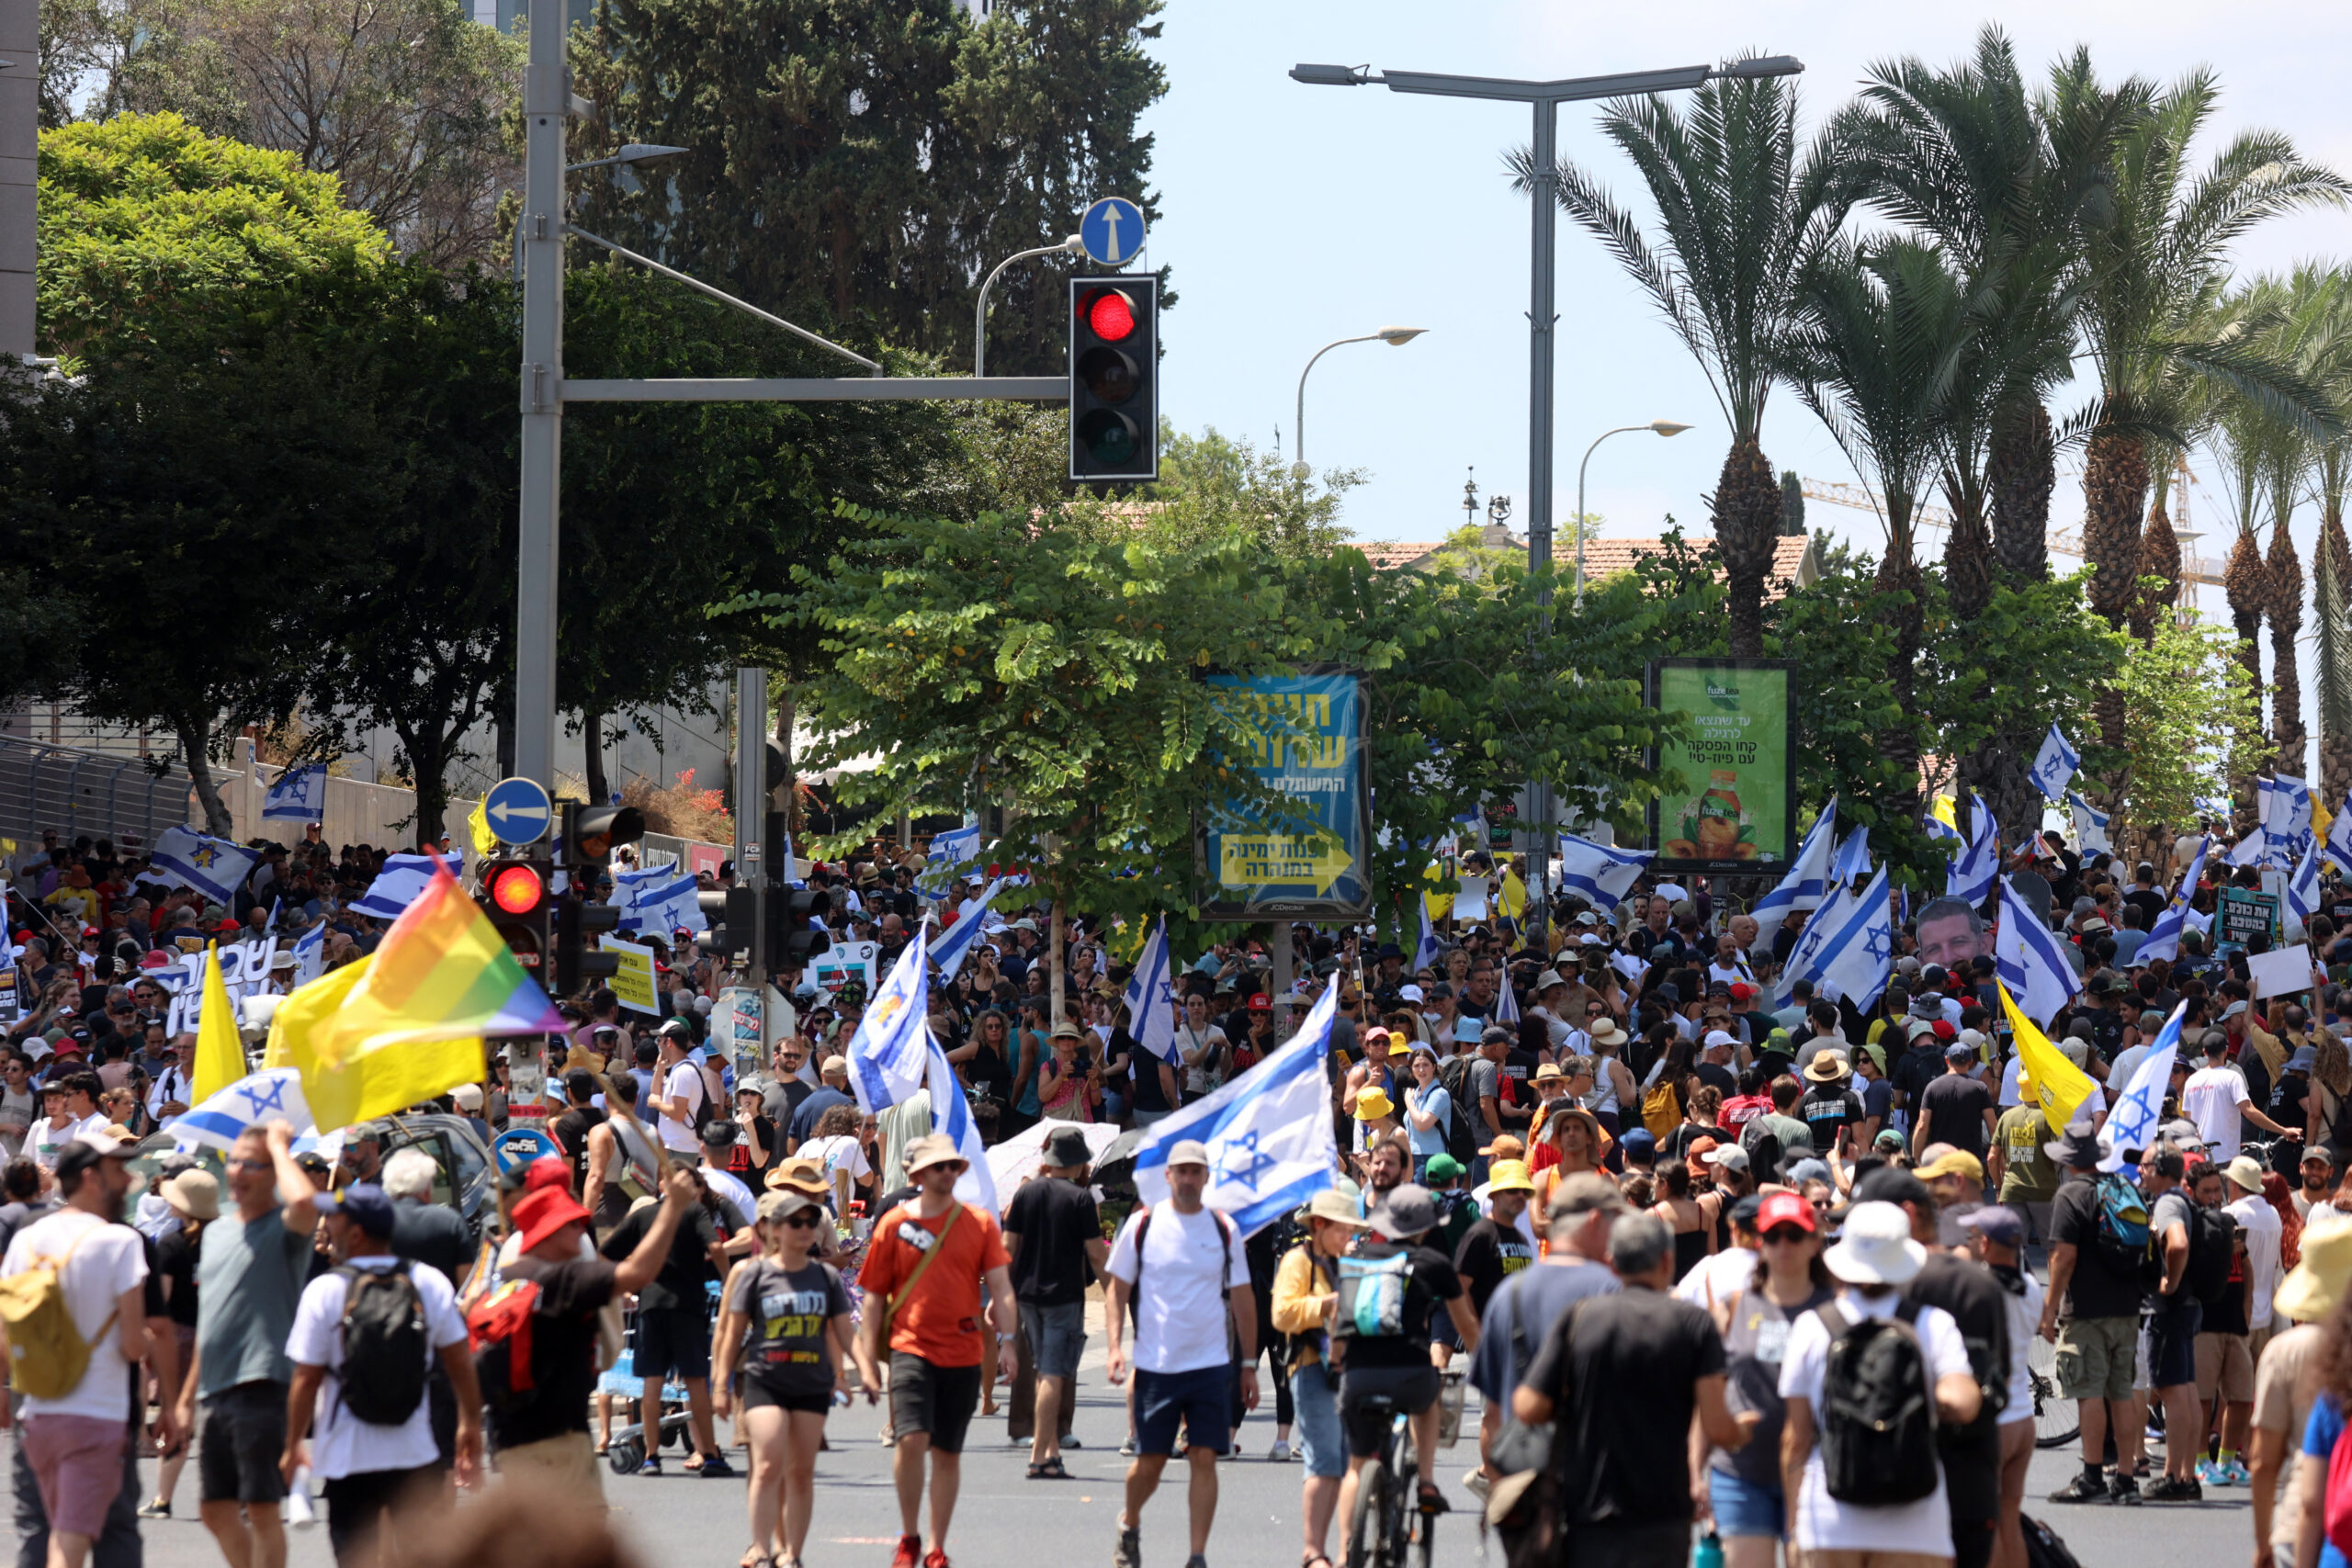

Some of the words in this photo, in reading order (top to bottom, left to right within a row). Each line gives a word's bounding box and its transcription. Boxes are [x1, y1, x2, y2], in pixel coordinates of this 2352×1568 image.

[1694, 716, 1733, 727] שתצאו
[1736, 716, 1751, 727] עד
[1224, 736, 1345, 768] שרונ
[1688, 740, 1731, 752] הפסקה
[1736, 741, 1758, 755] קחו
[1738, 754, 1755, 764] עם
[1272, 774, 1345, 792] המשתלם
[1228, 843, 1276, 858] ימינה
[1280, 843, 1328, 859] נות
[1245, 862, 1315, 877] במנהרה
[2255, 906, 2269, 918] את
